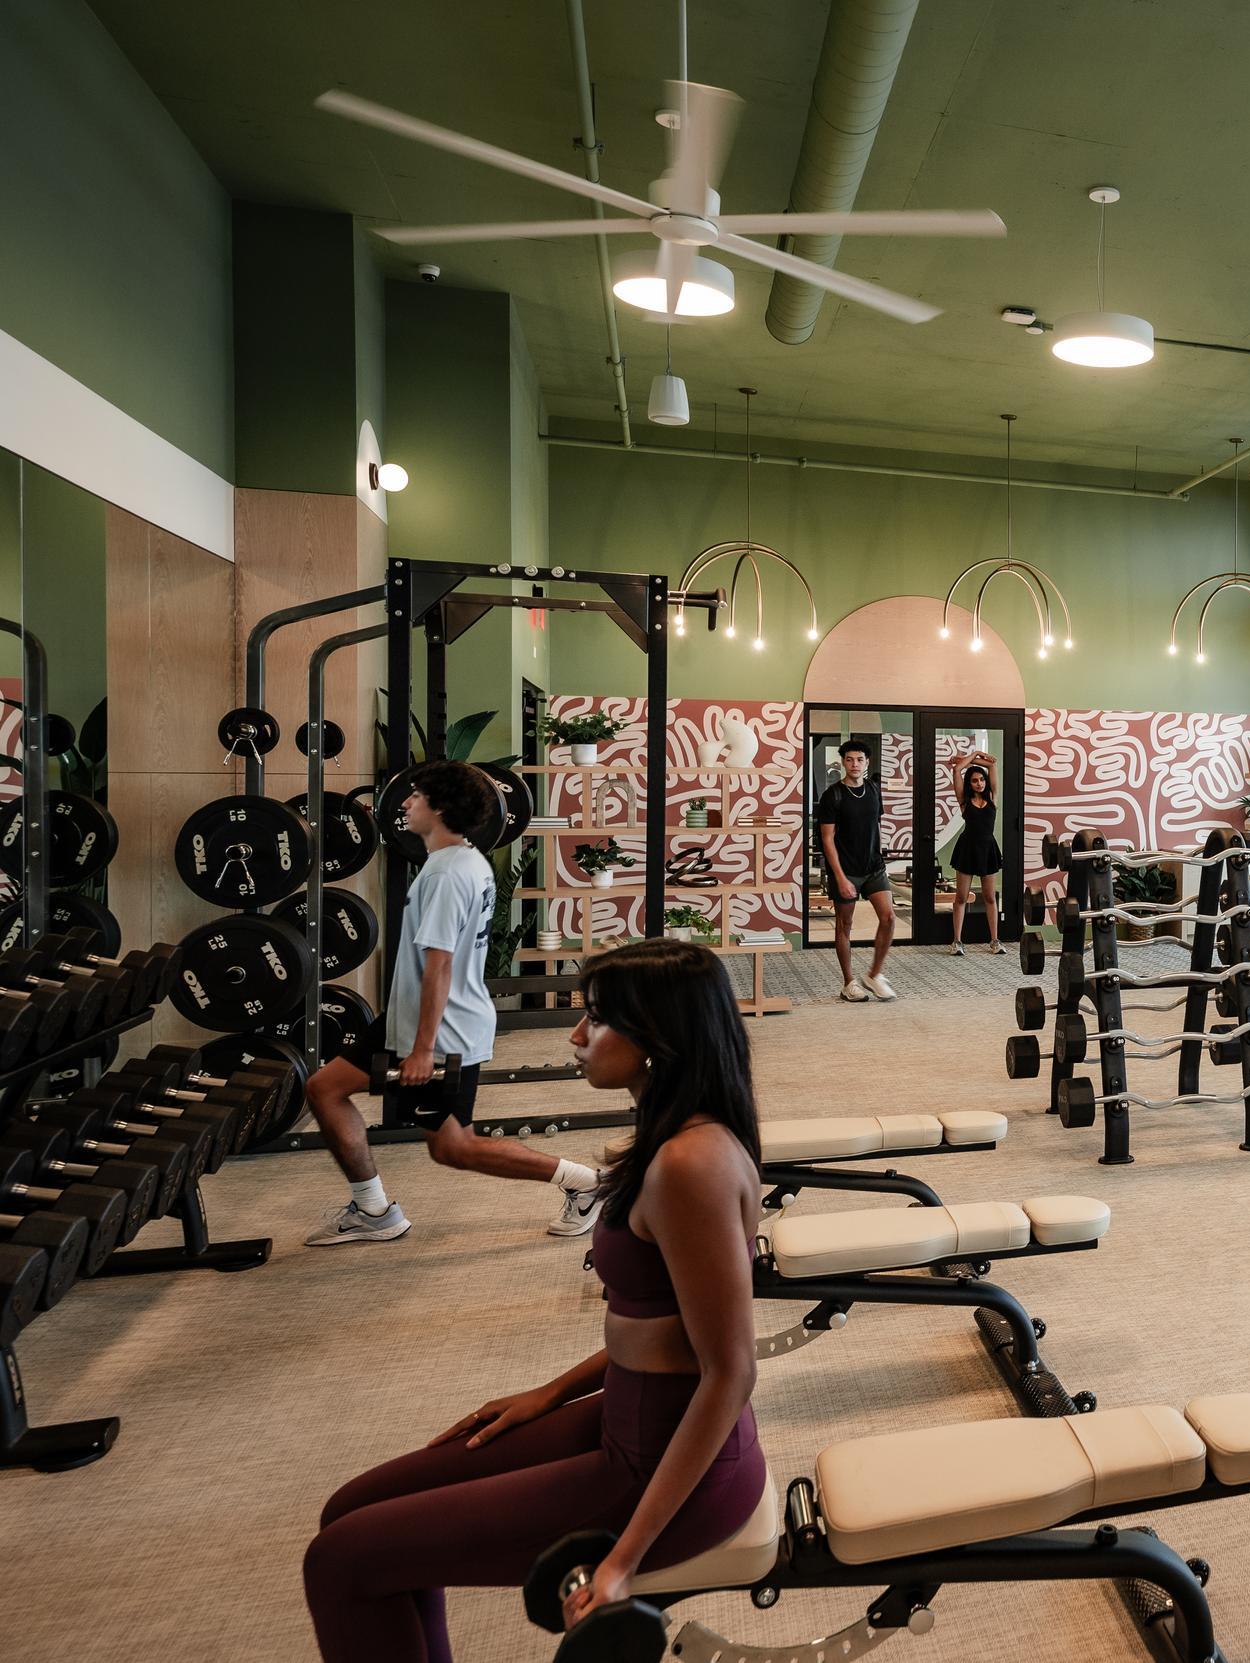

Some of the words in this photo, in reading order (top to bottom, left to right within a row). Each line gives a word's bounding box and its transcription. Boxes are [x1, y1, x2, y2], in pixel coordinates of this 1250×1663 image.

[229, 810, 237, 822] LB
[237, 808, 247, 822] 10
[192, 834, 207, 875] TKO
[277, 830, 292, 871] TKO
[325, 861, 334, 871] 10
[239, 884, 248, 896] 10
[337, 908, 358, 940] TKO
[207, 939, 217, 951] LB
[215, 934, 228, 949] 25
[260, 941, 288, 981] TKO
[323, 956, 335, 968] 25
[183, 969, 211, 1010] TKO
[244, 1001, 258, 1016] 25
[320, 1002, 346, 1014] KO
[276, 1023, 290, 1031] 45
